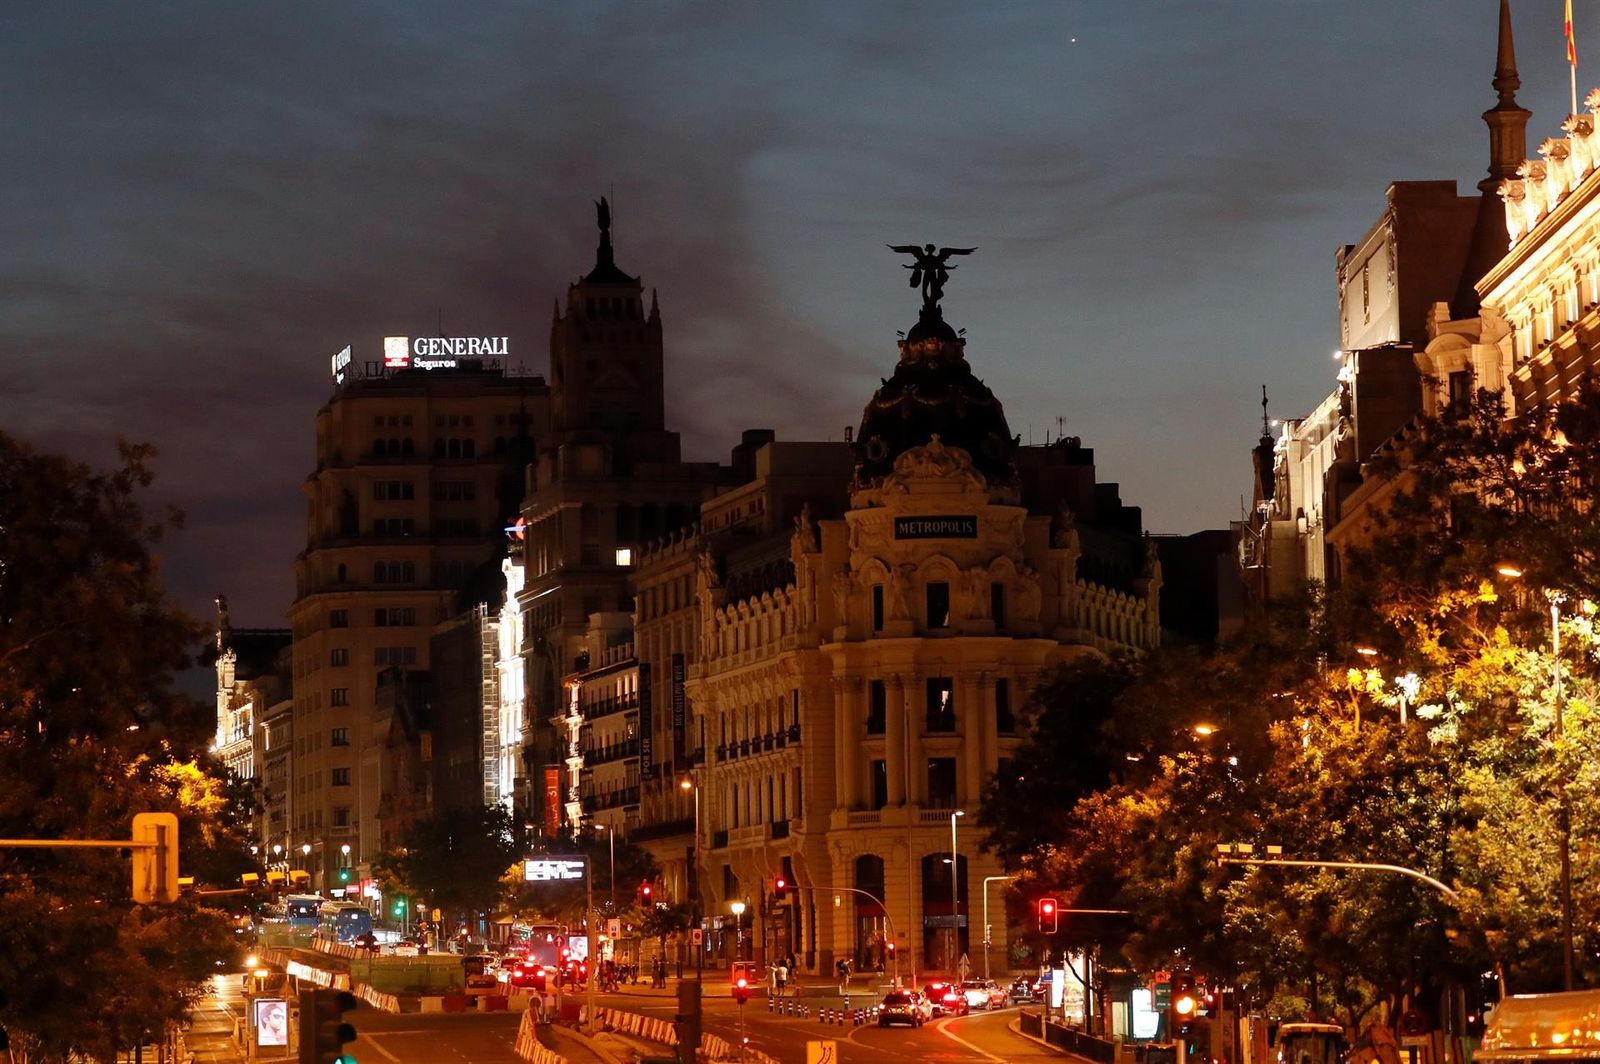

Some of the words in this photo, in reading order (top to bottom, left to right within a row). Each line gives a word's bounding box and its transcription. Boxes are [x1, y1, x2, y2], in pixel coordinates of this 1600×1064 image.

[414, 337, 509, 355] GENERALI
[414, 357, 456, 371] Seguros
[899, 521, 973, 534] METROPOLIS
[642, 737, 651, 753] SER
[642, 754, 651, 774] POR
